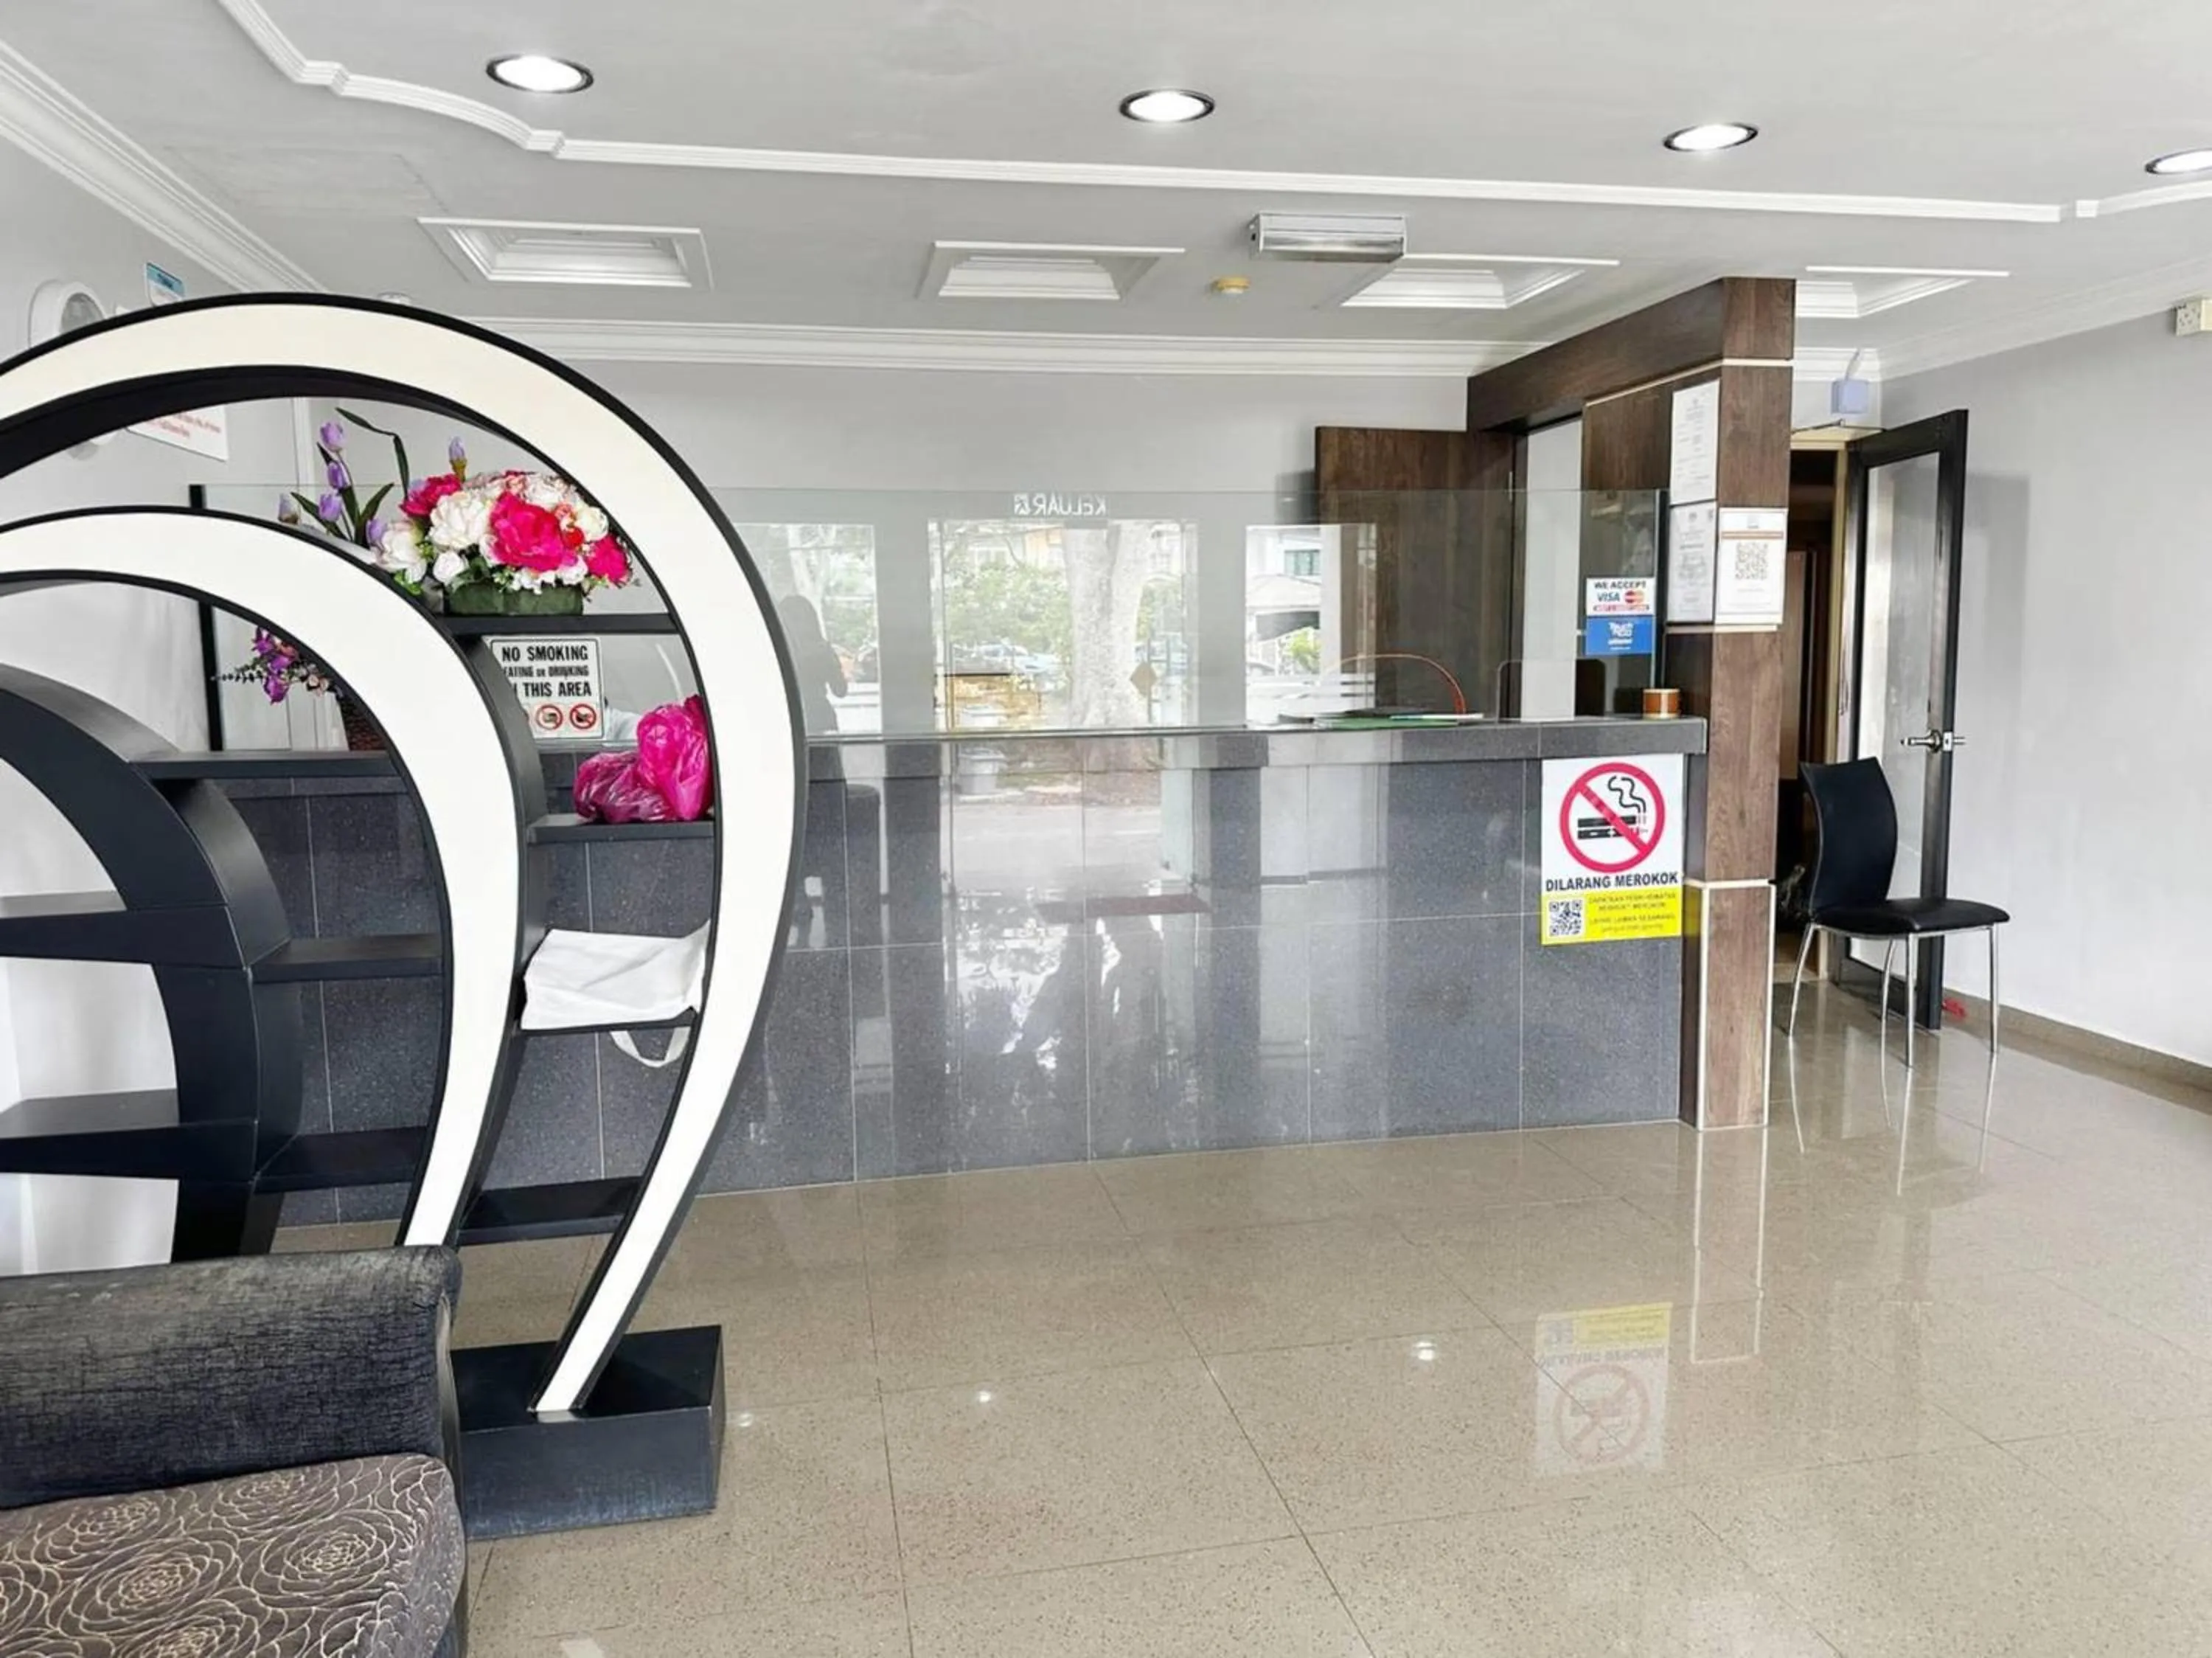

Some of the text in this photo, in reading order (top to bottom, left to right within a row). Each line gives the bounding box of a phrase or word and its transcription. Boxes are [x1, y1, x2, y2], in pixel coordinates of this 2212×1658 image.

[1597, 592, 1620, 602] VISA
[502, 645, 588, 662] NO SMOKING
[523, 682, 552, 697] THIS
[558, 681, 591, 697] AREA
[1545, 872, 1678, 892] DILARANG MEROKOK
